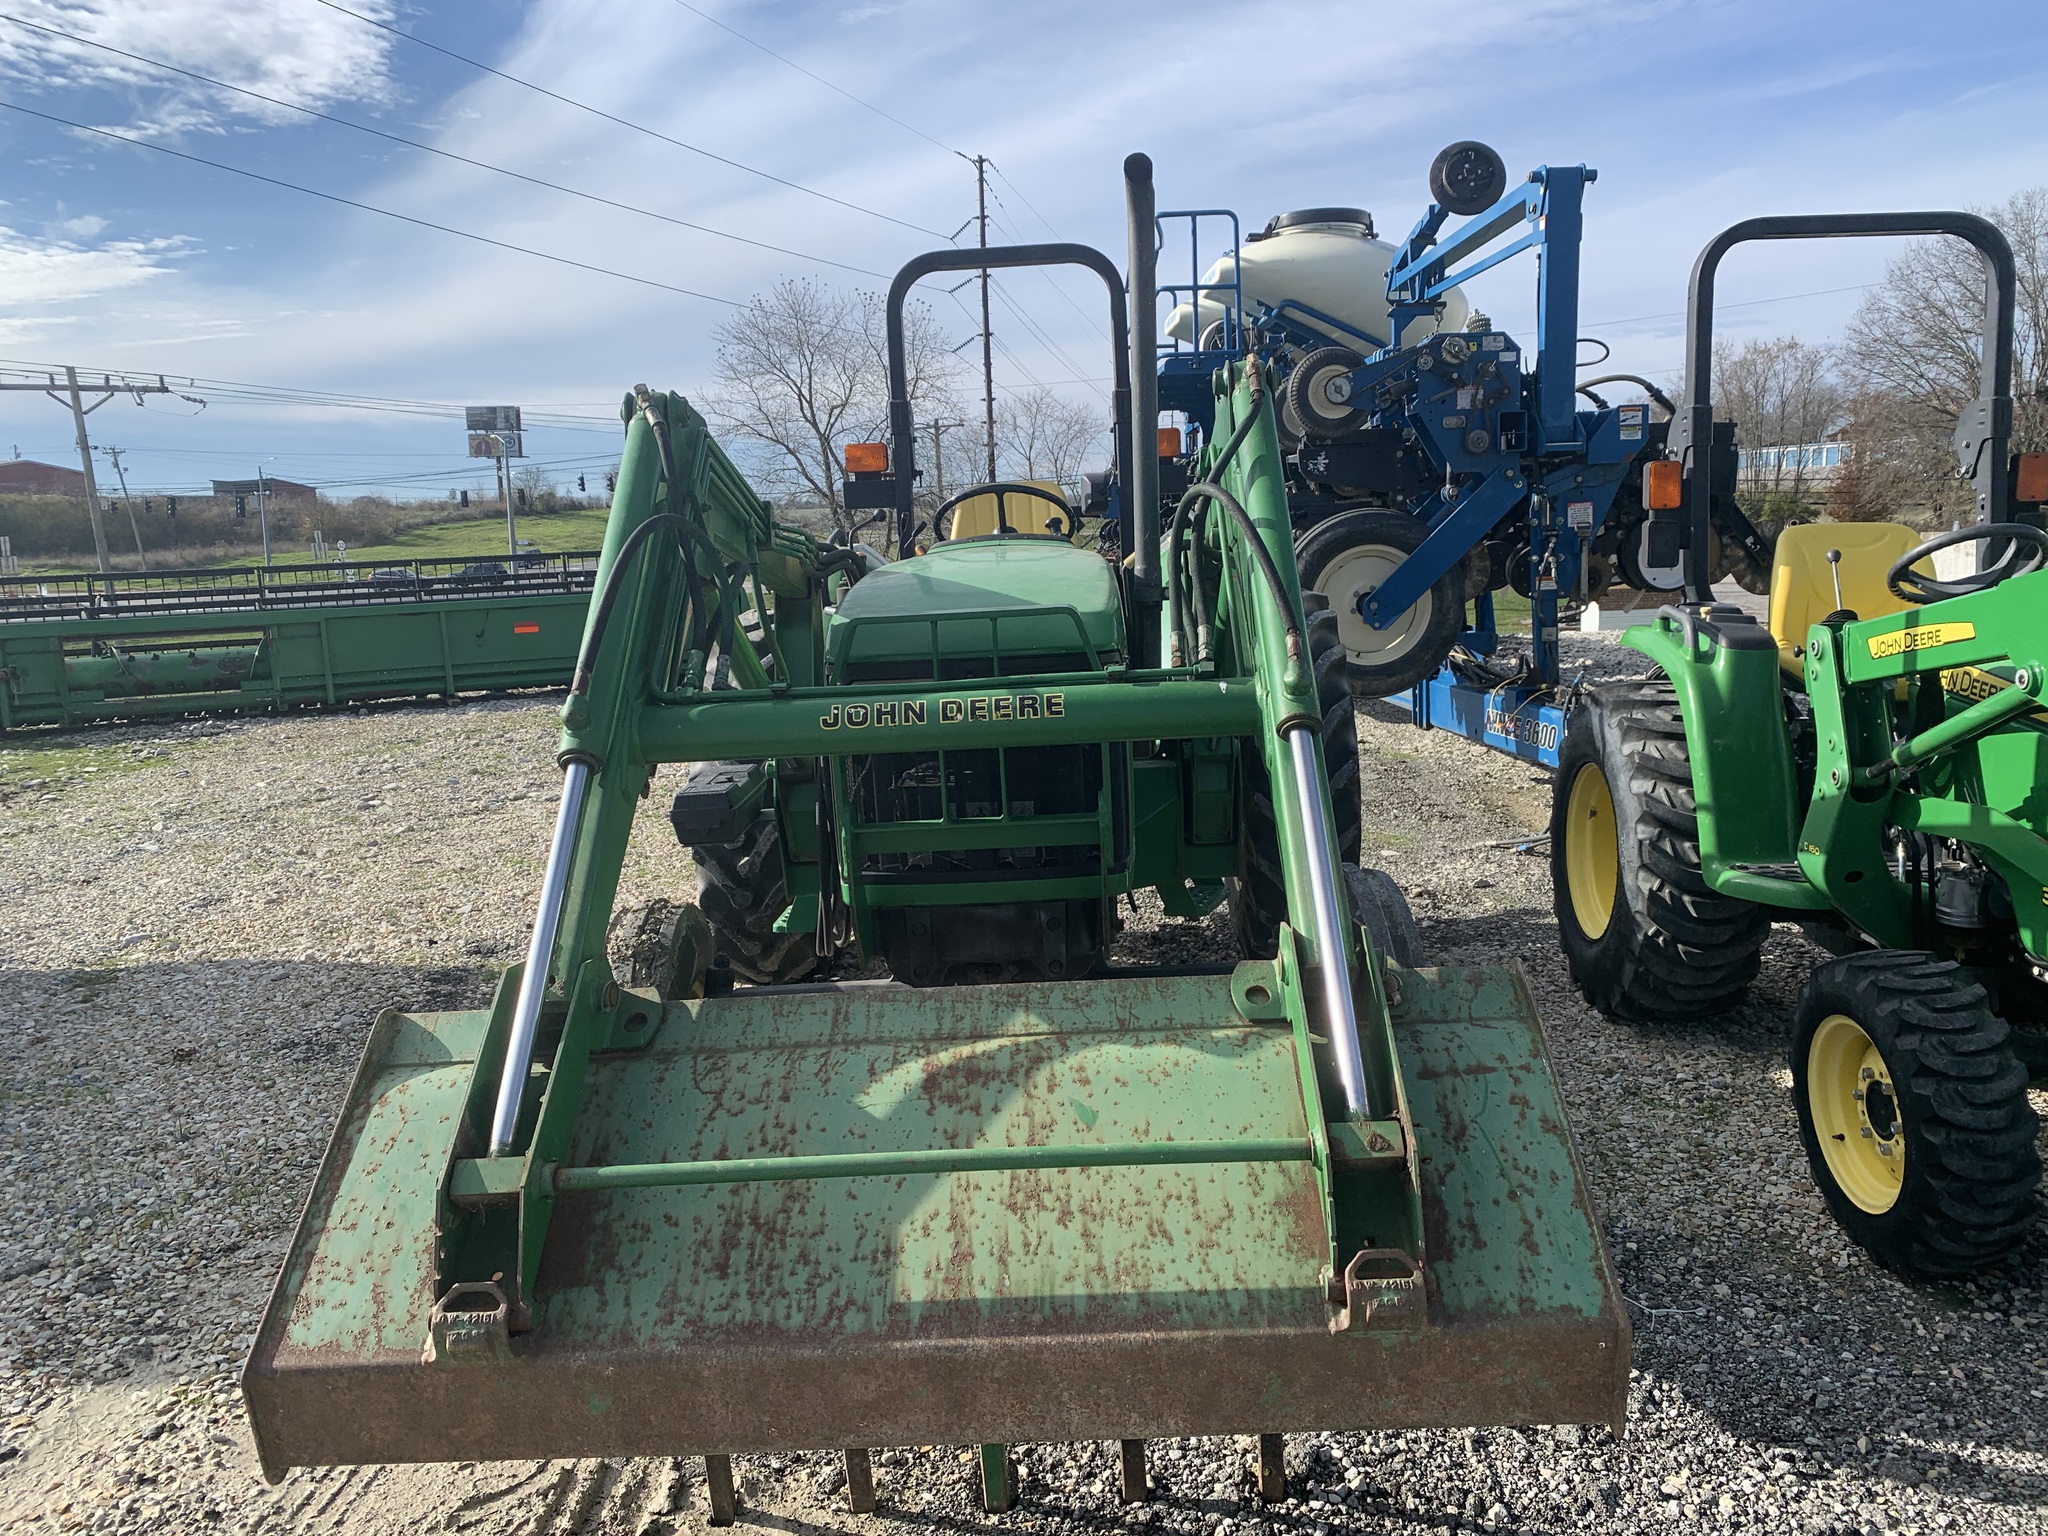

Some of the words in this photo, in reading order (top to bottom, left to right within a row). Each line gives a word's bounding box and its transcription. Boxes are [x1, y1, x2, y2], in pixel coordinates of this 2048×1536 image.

[1873, 637, 1902, 655] JOHN
[1904, 629, 1942, 650] DEERE
[1960, 670, 2006, 700] DEER
[820, 700, 927, 730] JOHN
[939, 693, 1065, 724] DEERE
[1523, 718, 1558, 751] 3600
